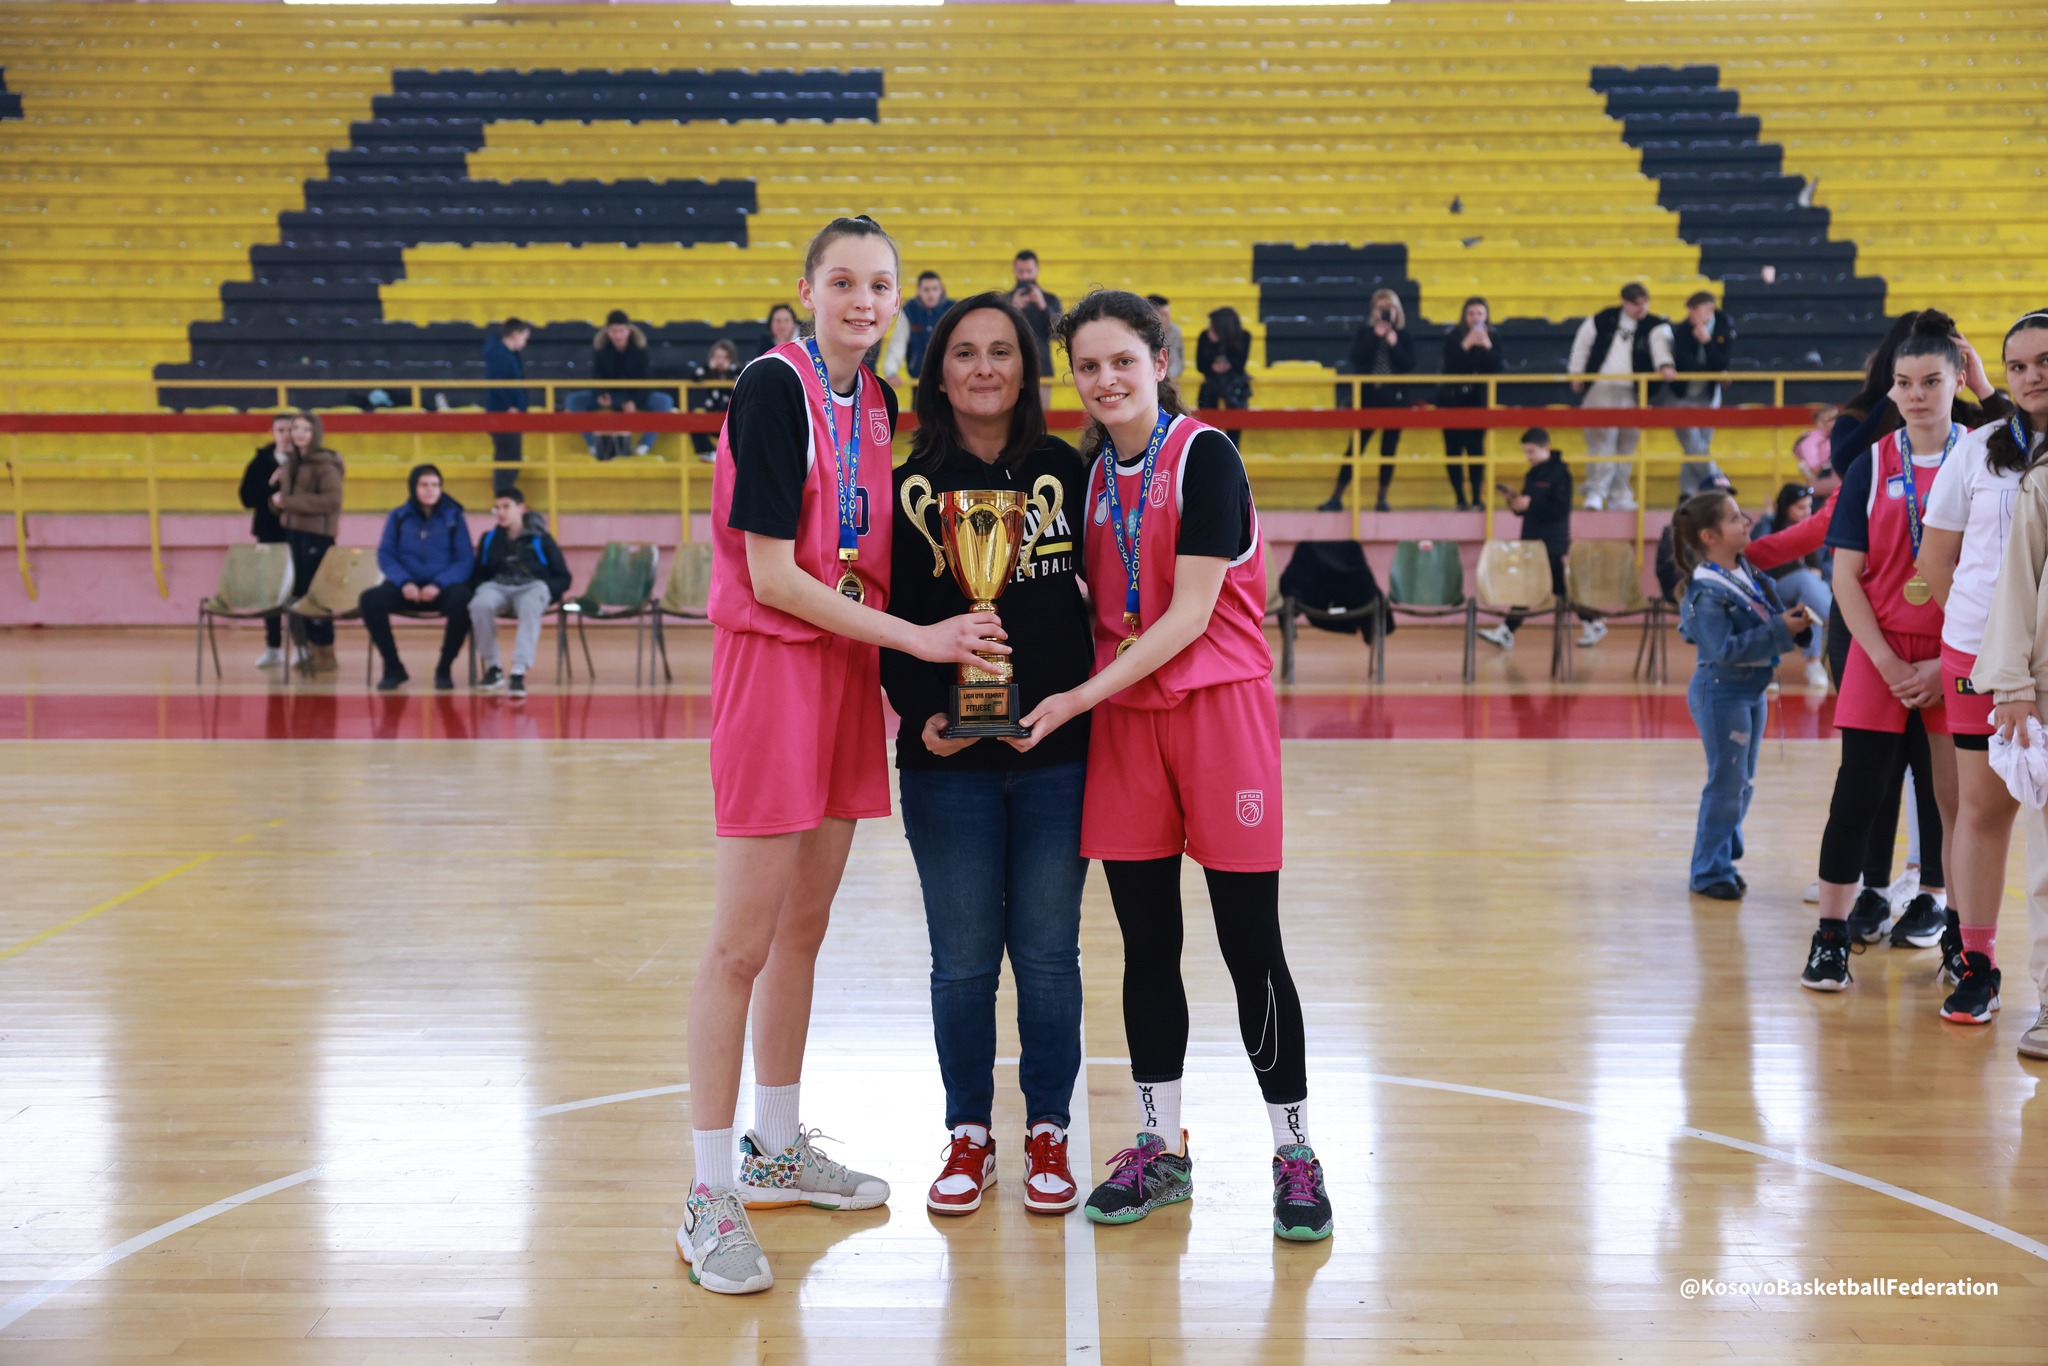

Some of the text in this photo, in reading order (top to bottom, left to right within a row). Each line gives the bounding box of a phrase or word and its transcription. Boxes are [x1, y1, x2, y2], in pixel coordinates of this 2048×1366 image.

[816, 367, 836, 431] KOSOVA
[836, 461, 849, 525] KOSOVA
[1105, 447, 1118, 506] KOSOVA
[1142, 436, 1160, 498] KOSOVA
[848, 467, 857, 530] KOSOVA
[1016, 556, 1073, 583] ETBALL
[966, 703, 992, 712] FITUESE
[1139, 1085, 1157, 1128] WORLD
[1284, 1105, 1306, 1144] WORLD
